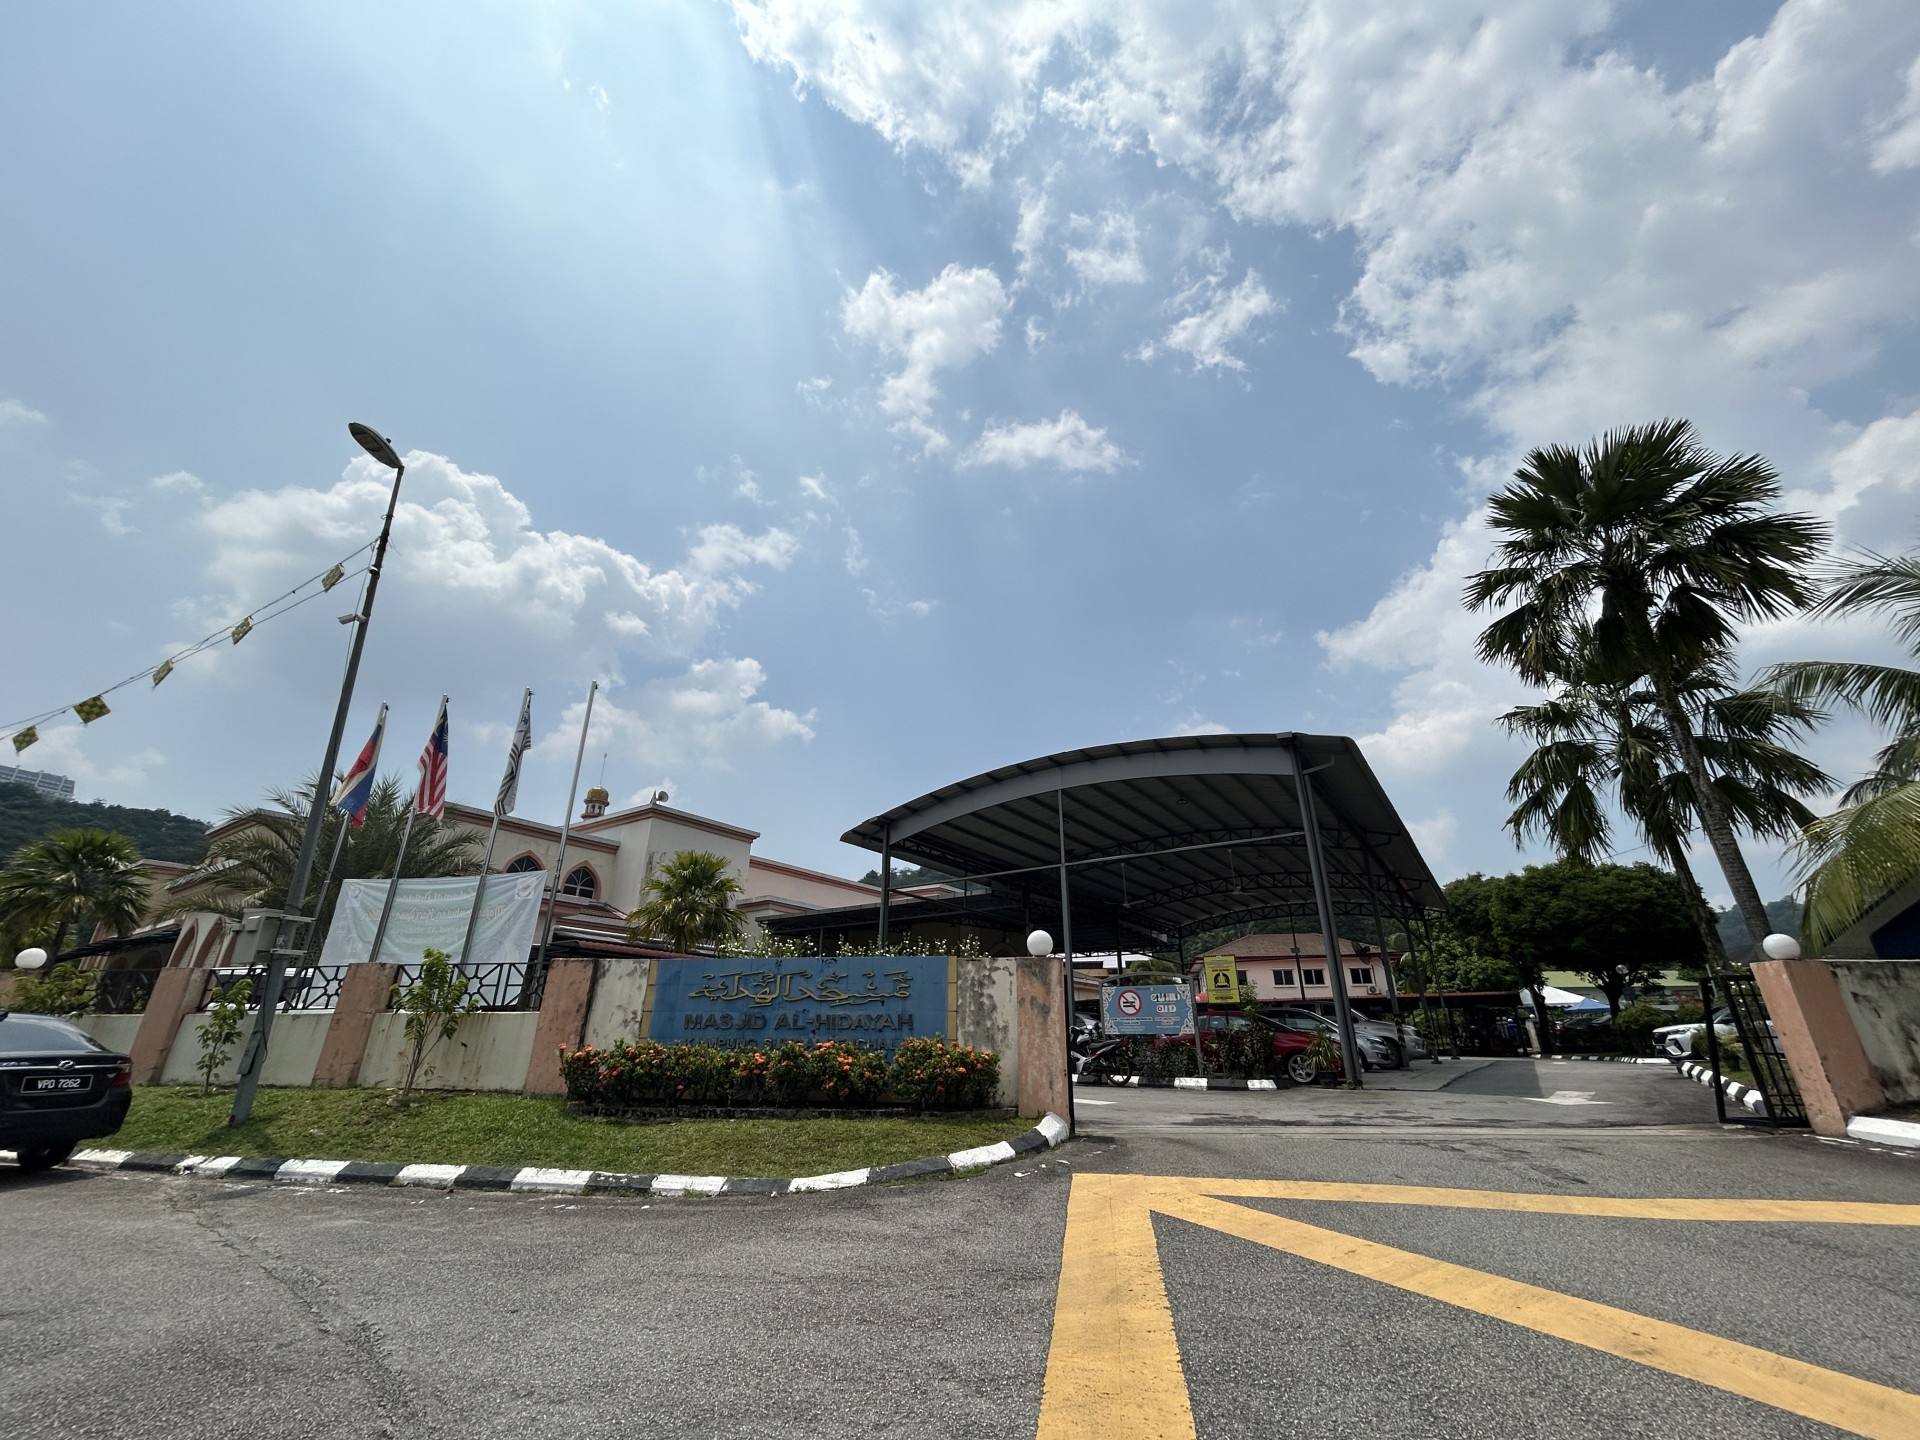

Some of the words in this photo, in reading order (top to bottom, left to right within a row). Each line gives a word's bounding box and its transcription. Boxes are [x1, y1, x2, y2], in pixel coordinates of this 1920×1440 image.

[684, 1013, 767, 1029] MASJID
[774, 1013, 914, 1030] AL-HIDAYAH
[58, 1078, 81, 1088] 7262
